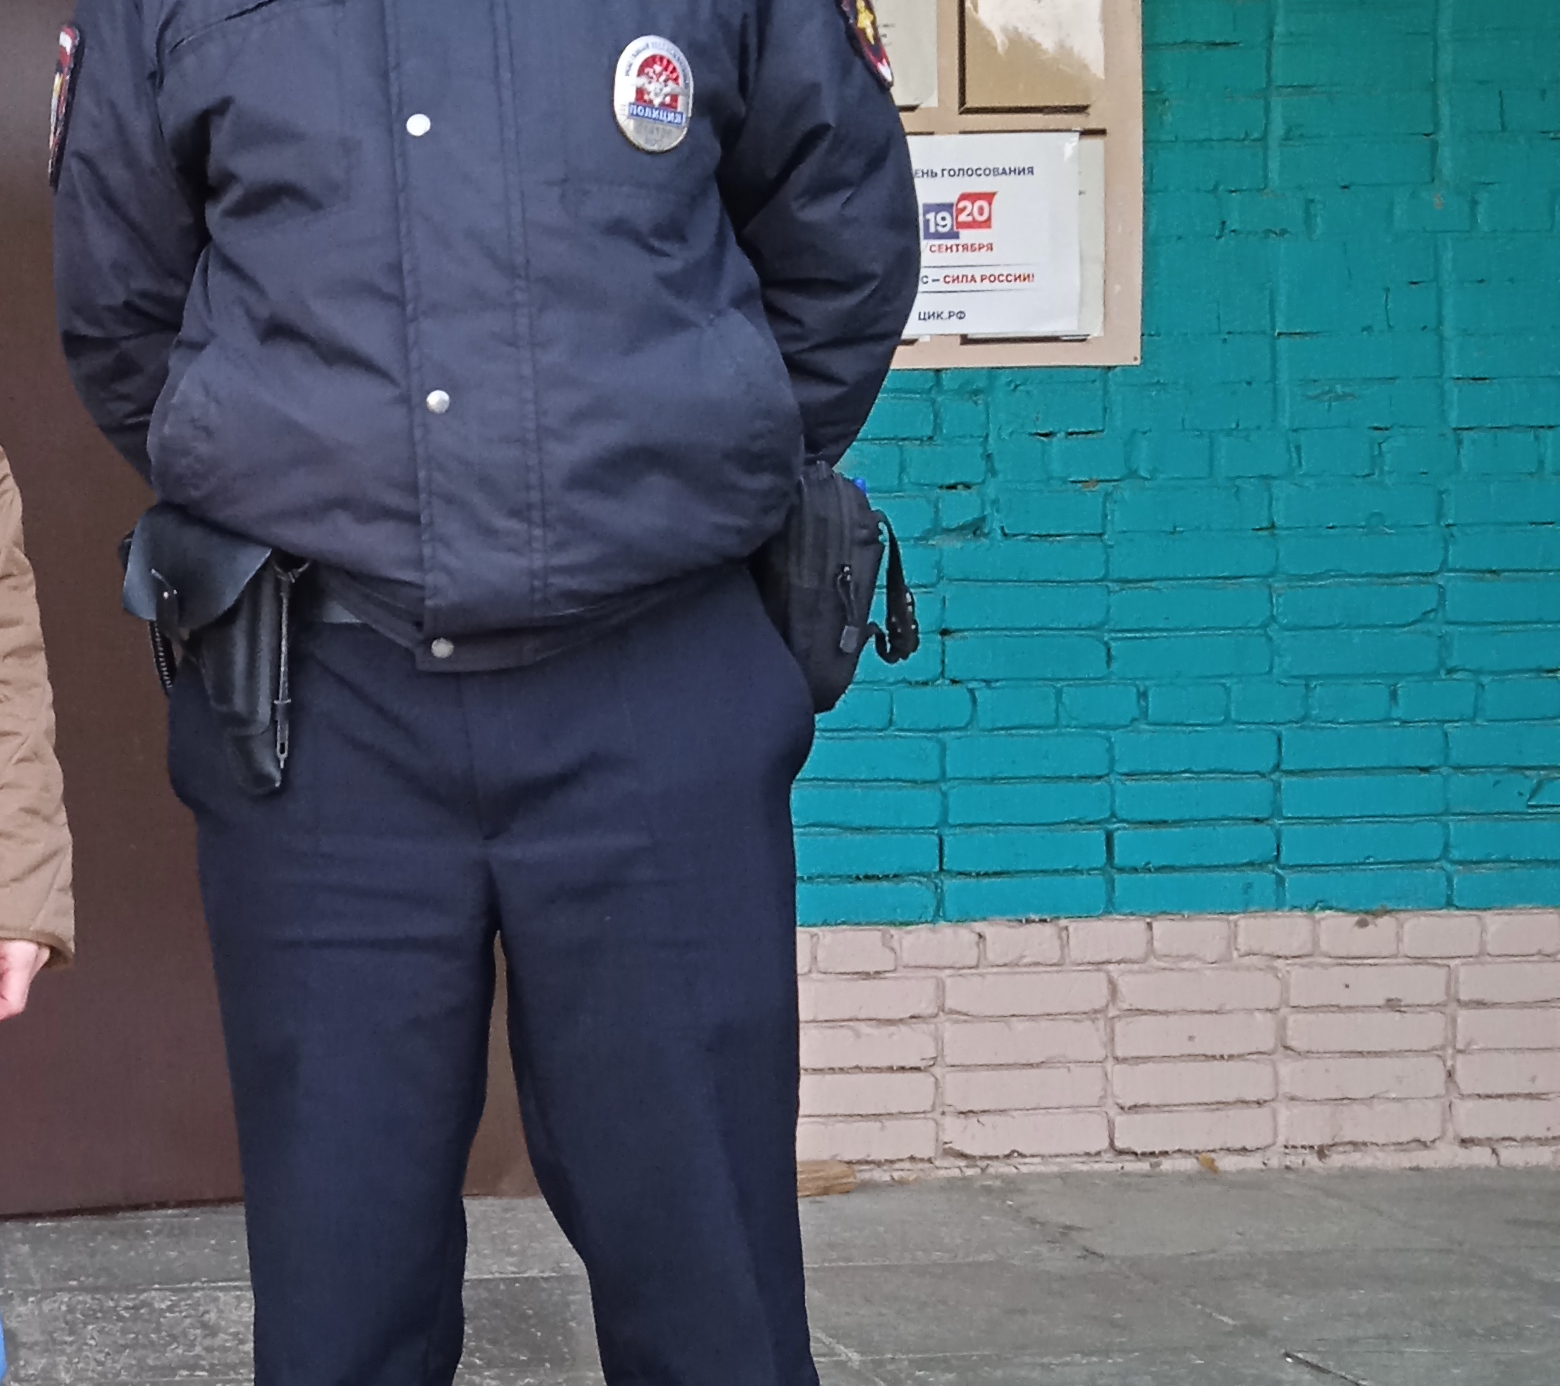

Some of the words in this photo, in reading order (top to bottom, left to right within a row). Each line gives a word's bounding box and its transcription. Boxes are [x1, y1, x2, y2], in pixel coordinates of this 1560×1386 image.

[629, 104, 683, 124] ПОЛИЦИЯ
[913, 168, 937, 179] ЕНЬ
[941, 166, 1034, 178] ГОЛОСОВАНИЯ
[925, 211, 952, 233] 19
[957, 200, 989, 222] 20
[929, 242, 994, 253] СЕНТЯБРЯ
[943, 274, 977, 284] СИЛА
[980, 272, 1035, 284] РОССИИ!
[918, 310, 966, 322] ЦИК.РФ
